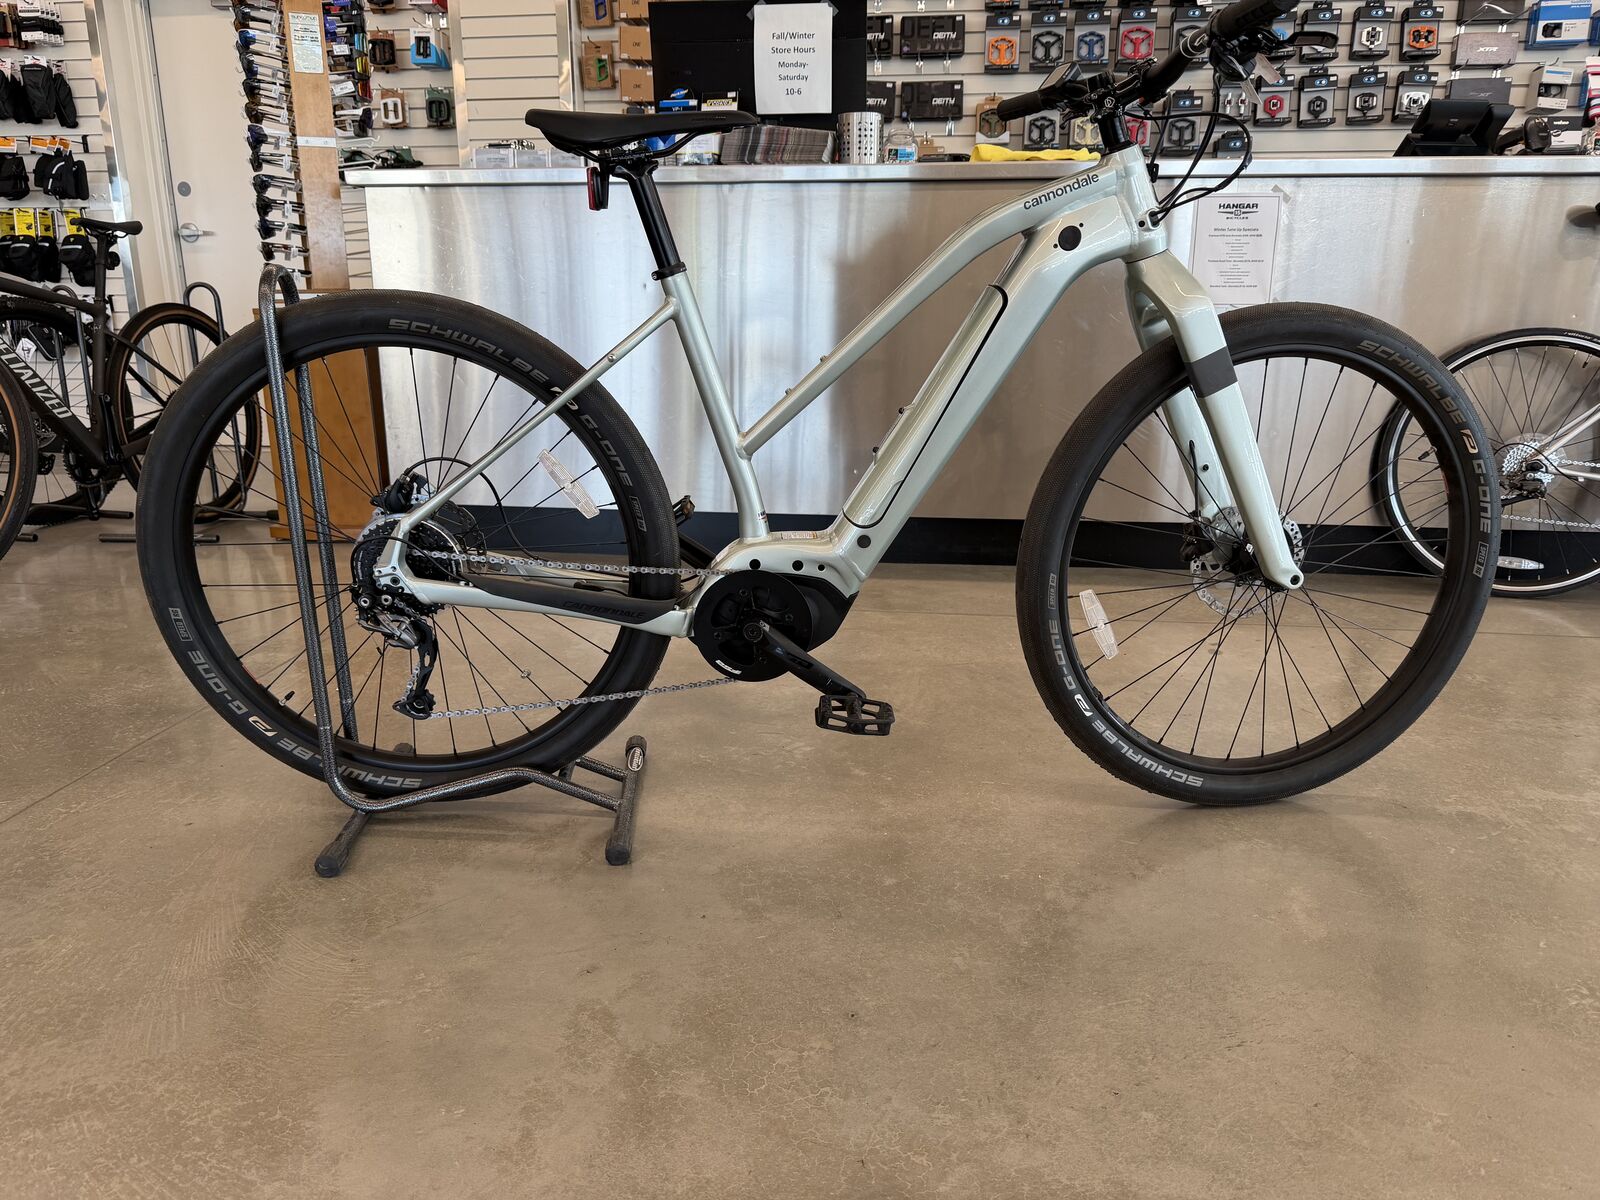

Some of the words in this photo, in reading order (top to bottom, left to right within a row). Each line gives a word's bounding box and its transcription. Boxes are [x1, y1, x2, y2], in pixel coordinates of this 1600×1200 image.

[771, 46, 792, 54] Store
[793, 46, 816, 54] Hours
[772, 32, 815, 41] Fall/Winter
[778, 61, 809, 71] Monday-
[778, 73, 809, 82] Saturday
[785, 87, 802, 96] 10-6
[931, 97, 956, 106] DEITY
[1023, 173, 1100, 210] cannondale
[1218, 202, 1259, 210] HANGAR
[388, 318, 551, 384] SCHWALBE
[1356, 339, 1468, 424] SCHWALBE
[580, 415, 634, 488] G-ONE
[1471, 459, 1492, 534] G-ONE
[1047, 619, 1077, 691] G-ONE
[187, 650, 249, 716] G-ONE
[1091, 718, 1205, 788] SCHWALBE
